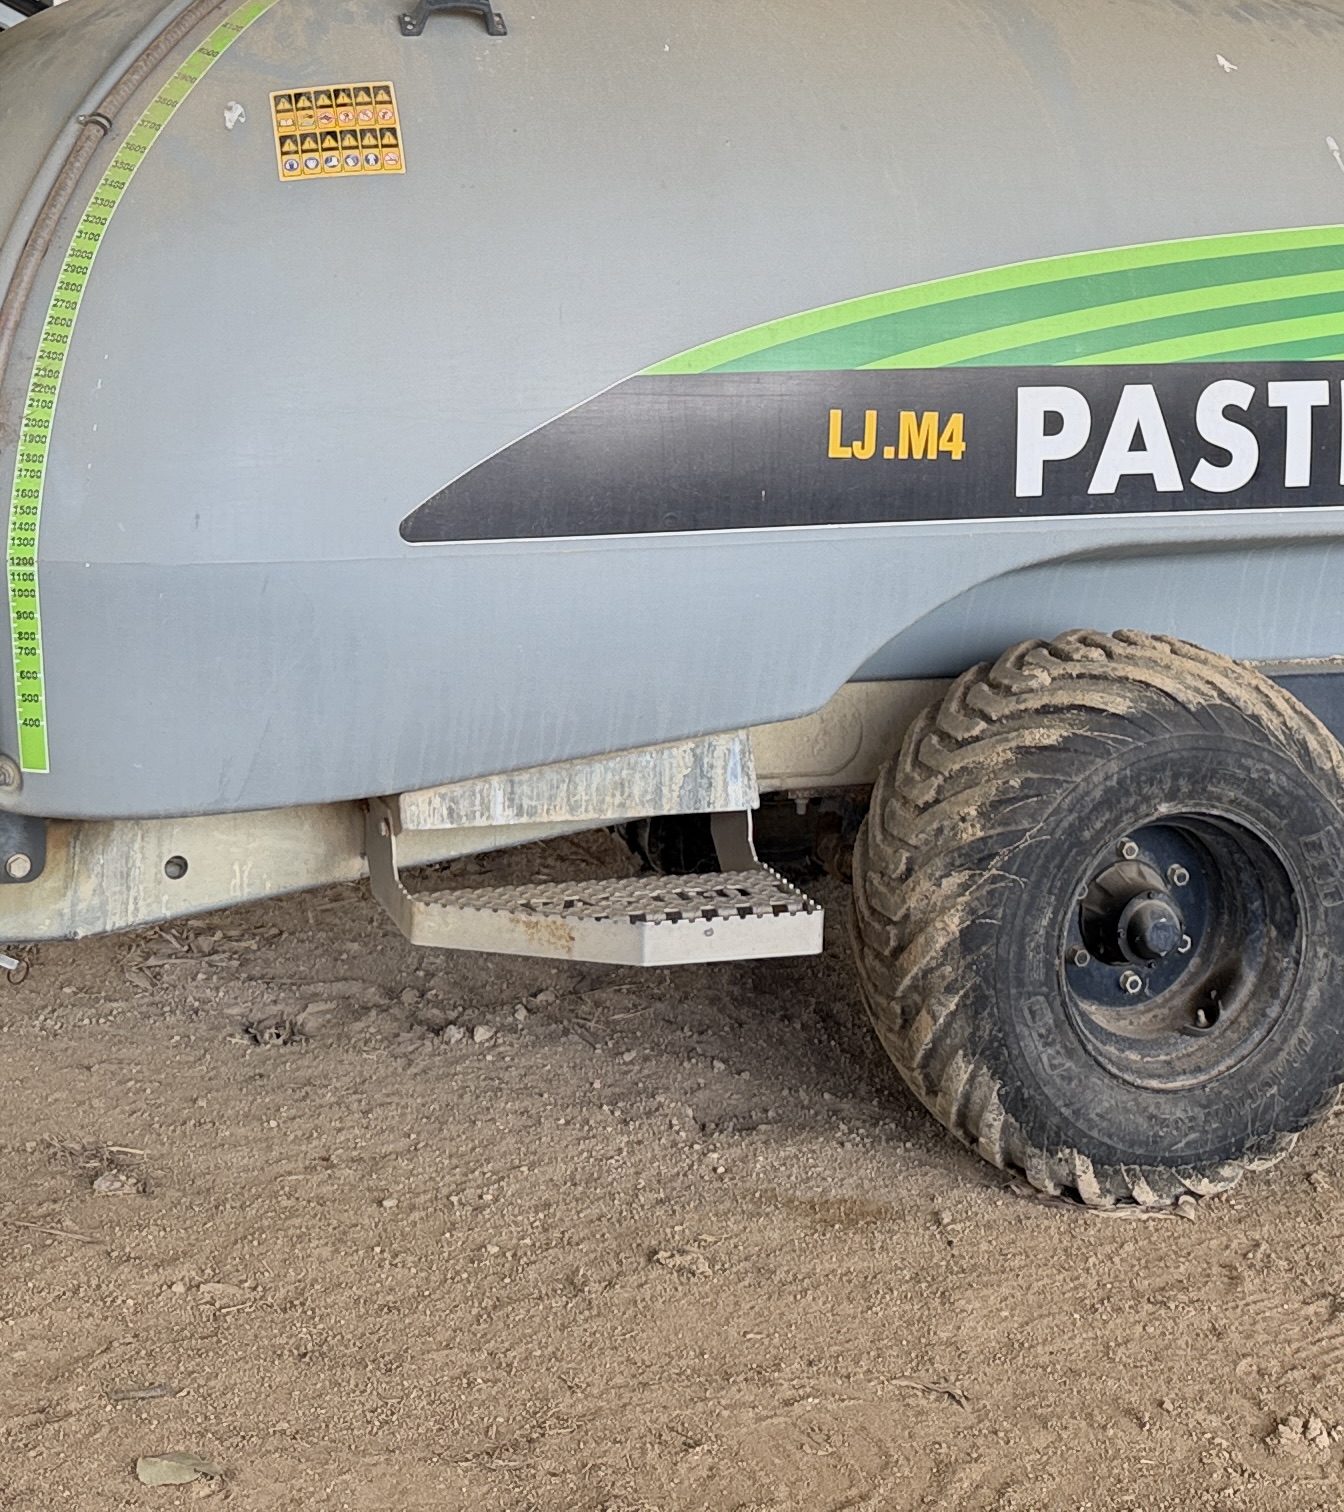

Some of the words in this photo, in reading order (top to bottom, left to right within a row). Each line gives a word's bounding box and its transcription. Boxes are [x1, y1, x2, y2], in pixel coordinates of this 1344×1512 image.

[76, 230, 101, 242] 3100
[63, 263, 89, 276] 2900
[57, 280, 83, 293] 2800
[52, 298, 78, 310] 2700
[42, 332, 69, 344] 2500
[38, 349, 65, 362] 2400
[34, 367, 61, 379] 2300
[30, 382, 57, 395] 2200
[27, 397, 54, 410] 2100
[24, 417, 50, 429] 2000
[22, 433, 48, 445] 1900
[828, 409, 967, 460] LJ.M4
[19, 452, 45, 464] 1800
[17, 467, 43, 479] 1700
[15, 488, 40, 499] 1600
[13, 505, 38, 516] 1500
[11, 521, 37, 532] 1400
[10, 536, 36, 547] 1300
[9, 556, 35, 567] 1200
[10, 571, 35, 582] 1100
[10, 588, 36, 599] 1000
[15, 610, 36, 621] 900
[17, 631, 36, 641] 800
[17, 646, 37, 656] 700
[19, 670, 39, 680] 600
[21, 693, 40, 703] 500
[22, 717, 41, 728] 400
